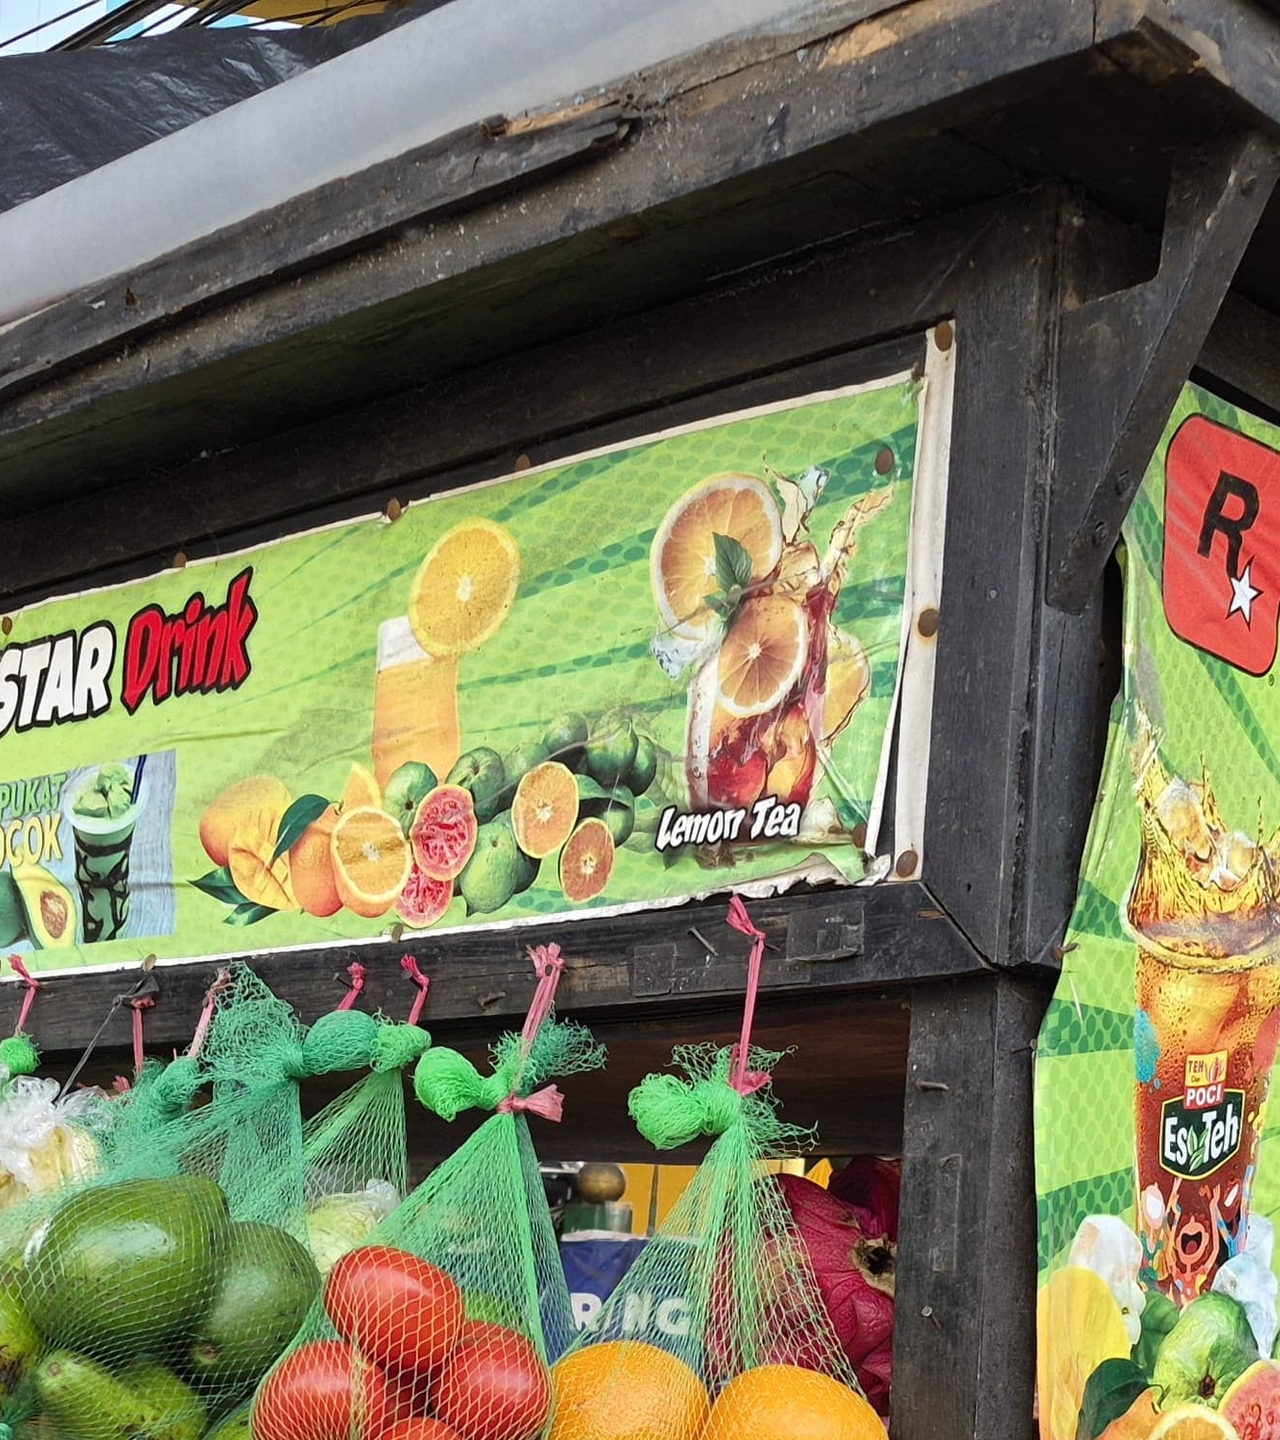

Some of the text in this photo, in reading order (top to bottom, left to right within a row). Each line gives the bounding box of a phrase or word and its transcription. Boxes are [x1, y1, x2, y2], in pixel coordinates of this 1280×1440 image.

[120, 567, 257, 714] Drink
[655, 795, 801, 852] Lemon Tea
[1188, 1060, 1204, 1073] TEH
[1186, 1084, 1222, 1107] POCI
[1164, 1103, 1239, 1165] Es Teh
